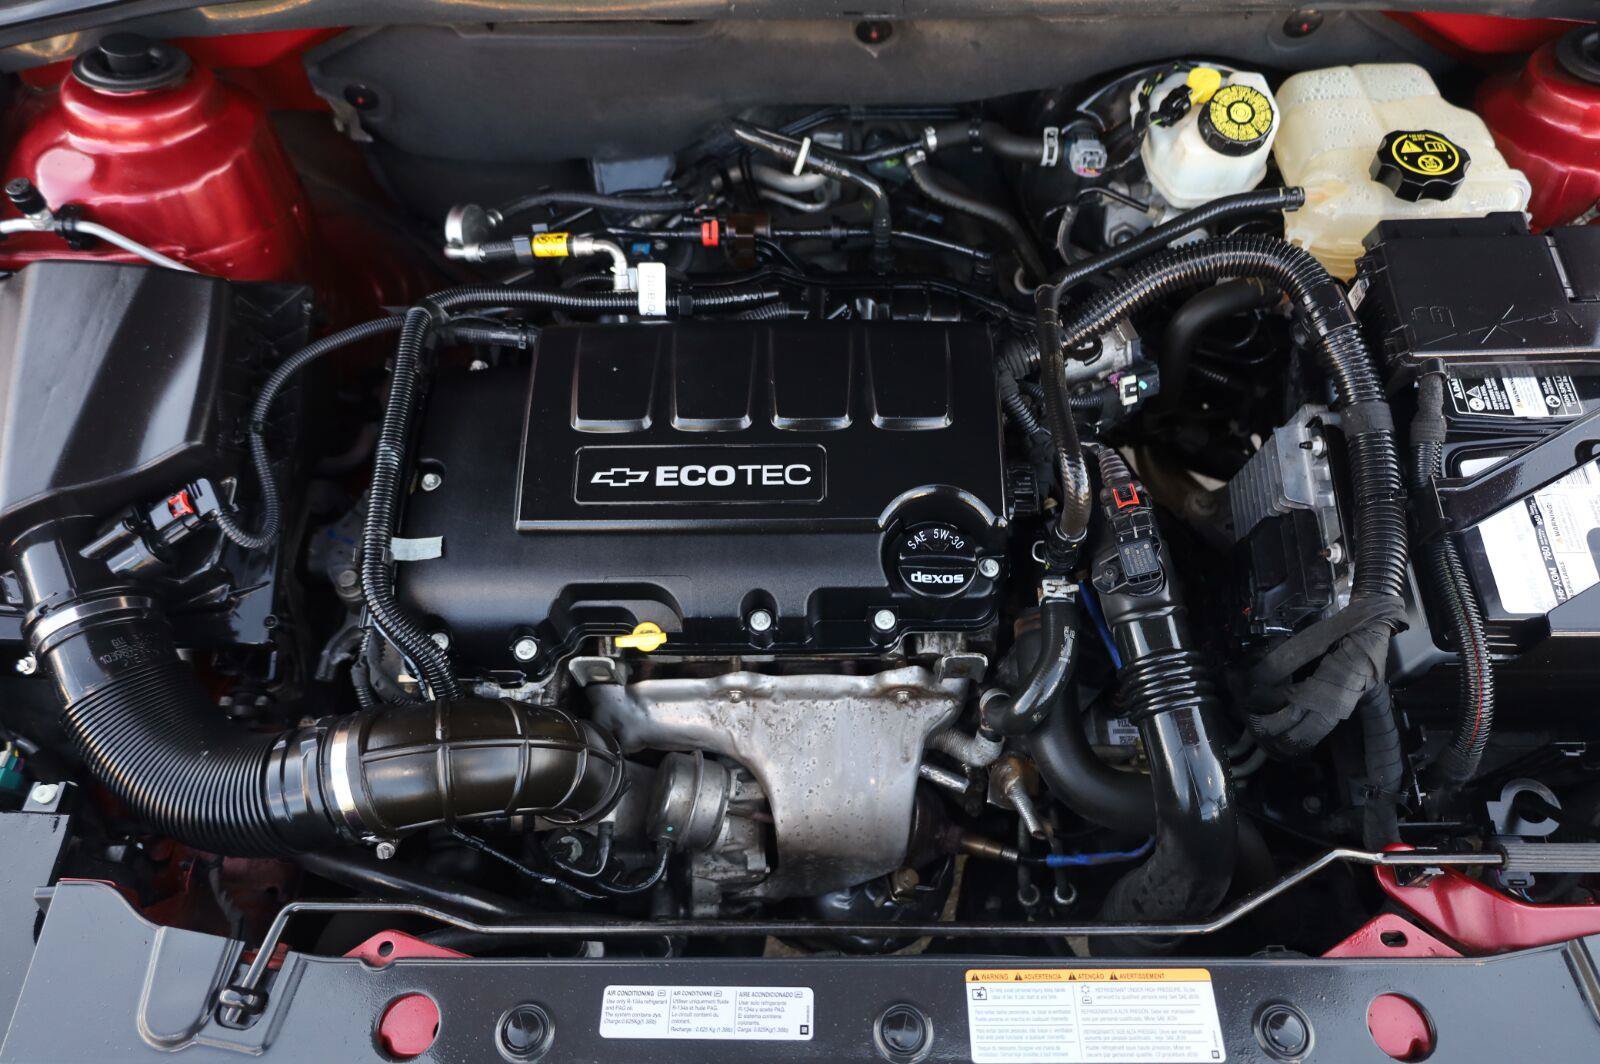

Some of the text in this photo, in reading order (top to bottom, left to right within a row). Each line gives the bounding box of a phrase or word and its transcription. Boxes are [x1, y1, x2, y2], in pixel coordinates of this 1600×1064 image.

[655, 464, 811, 487] ECOTEC
[908, 528, 964, 550] SAE 5W-30
[910, 571, 964, 584] dexos
